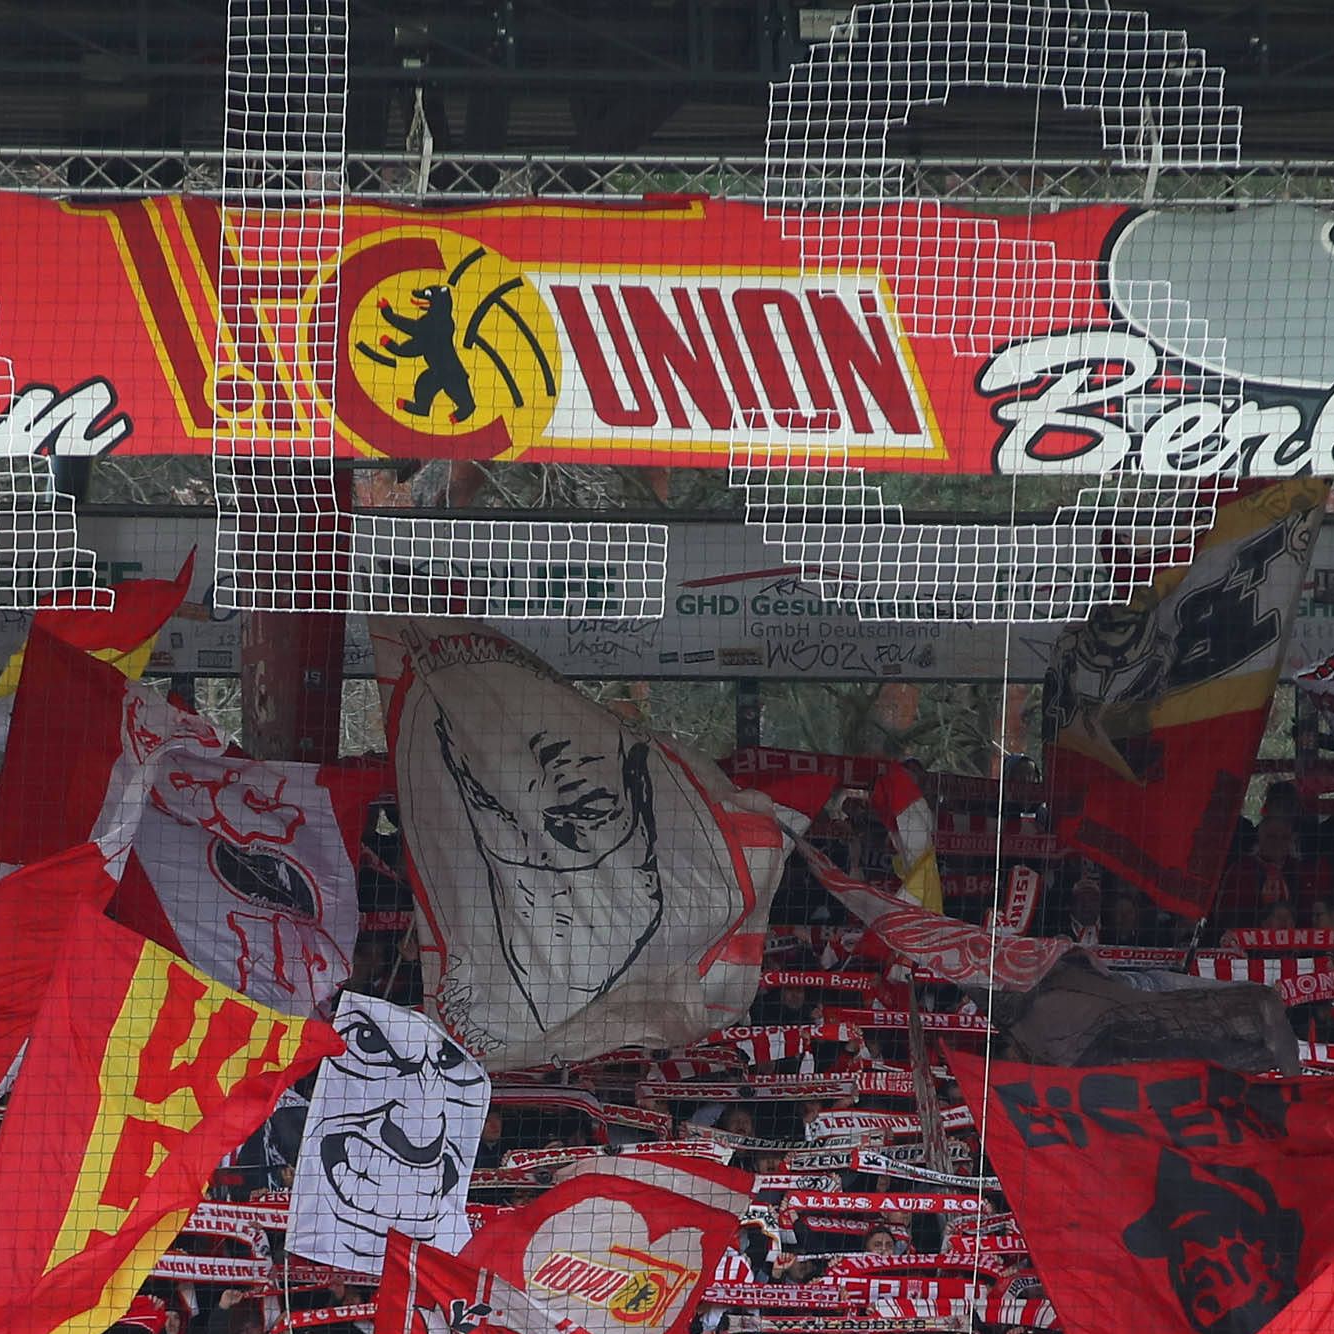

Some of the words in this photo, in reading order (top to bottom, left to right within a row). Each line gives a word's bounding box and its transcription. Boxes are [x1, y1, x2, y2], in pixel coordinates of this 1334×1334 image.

[551, 284, 923, 434] UNION
[675, 594, 740, 617] GHD
[750, 622, 810, 639] GmbH
[819, 622, 942, 639] Deutschland
[790, 1196, 870, 1212] ALLES
